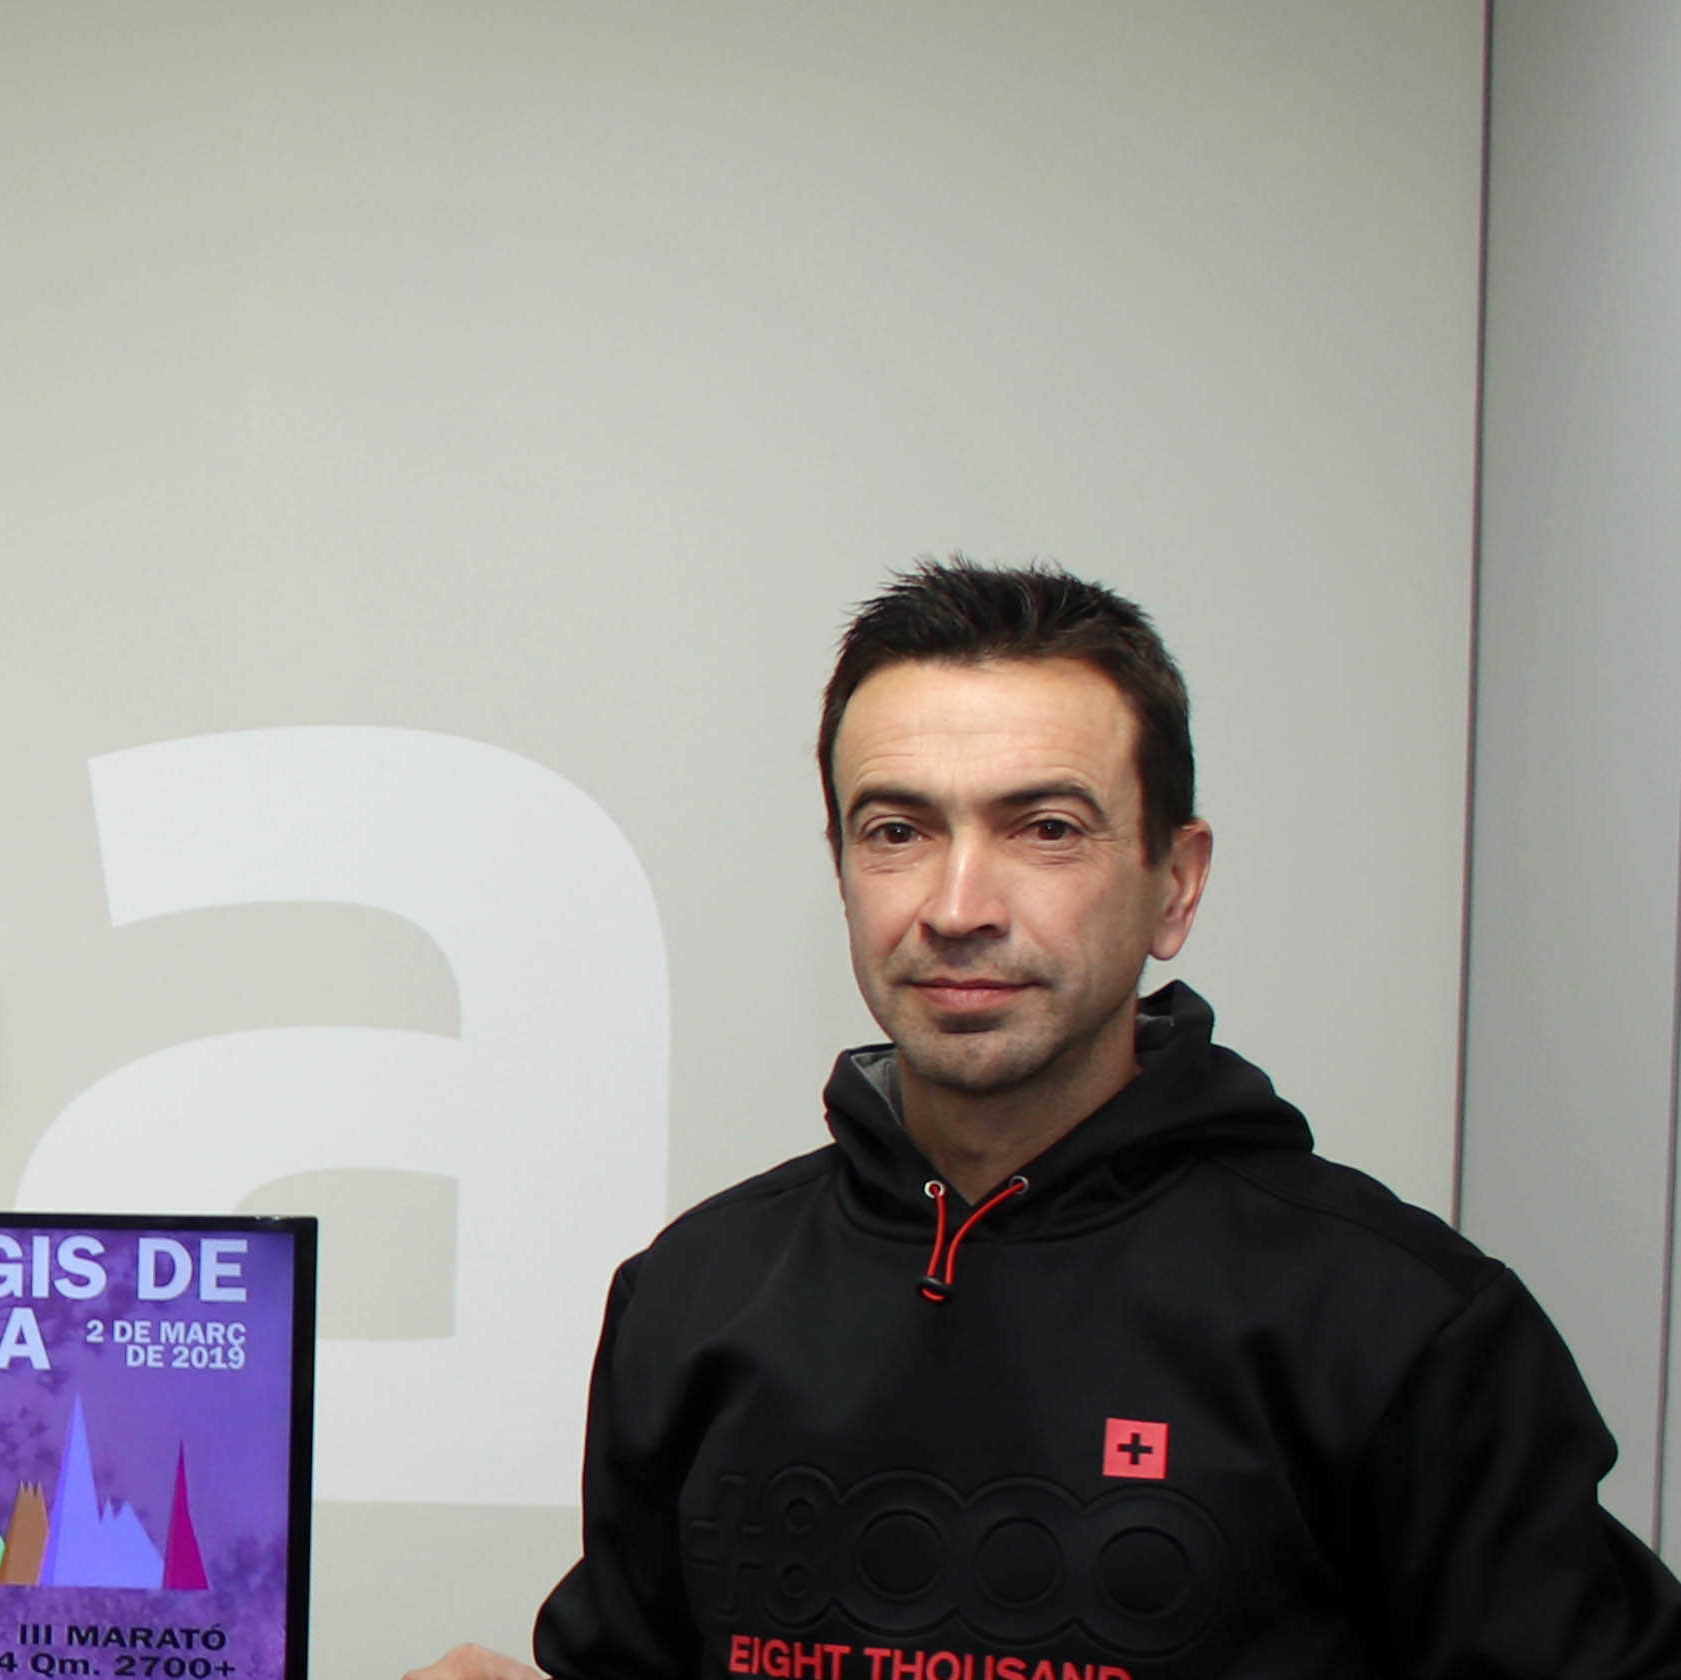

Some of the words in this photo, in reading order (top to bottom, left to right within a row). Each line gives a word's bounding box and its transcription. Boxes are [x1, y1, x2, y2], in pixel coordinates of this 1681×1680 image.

[138, 1238, 248, 1302] DE
[86, 1319, 105, 1344] 2
[114, 1321, 155, 1344] DE
[160, 1321, 246, 1348] MARÇ
[126, 1345, 165, 1368] DE
[171, 1346, 245, 1370] 2019
[20, 1623, 53, 1645] III
[68, 1621, 226, 1650] MARATÓ
[30, 1653, 100, 1678] Qm.
[114, 1655, 236, 1679] 2700+
